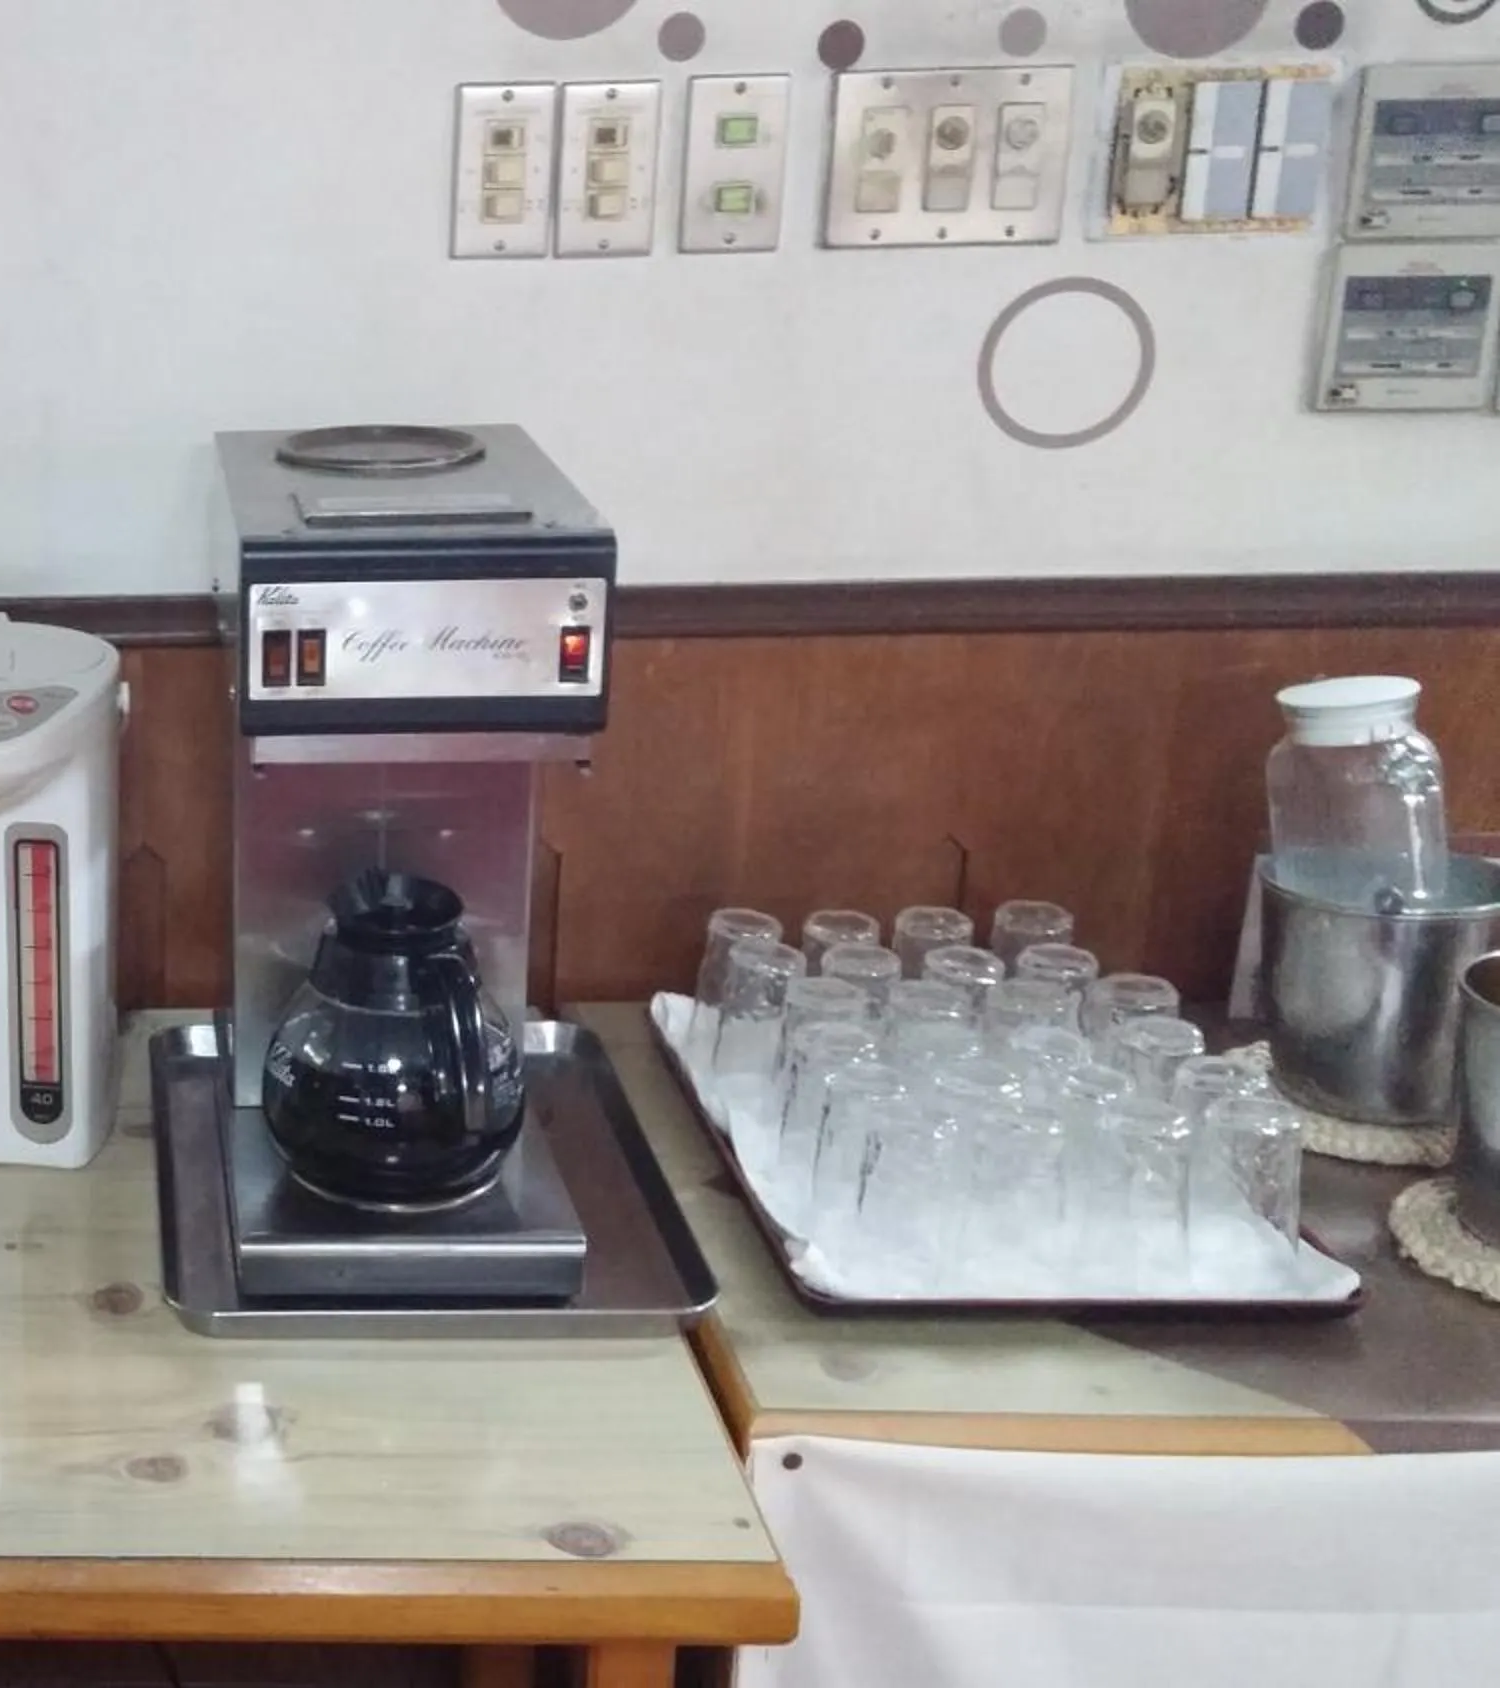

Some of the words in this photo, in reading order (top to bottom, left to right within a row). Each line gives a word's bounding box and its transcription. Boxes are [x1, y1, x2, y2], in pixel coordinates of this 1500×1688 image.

[342, 628, 408, 662] Coffee
[429, 625, 526, 651] Machine
[364, 1117, 395, 1128] 1.0L
